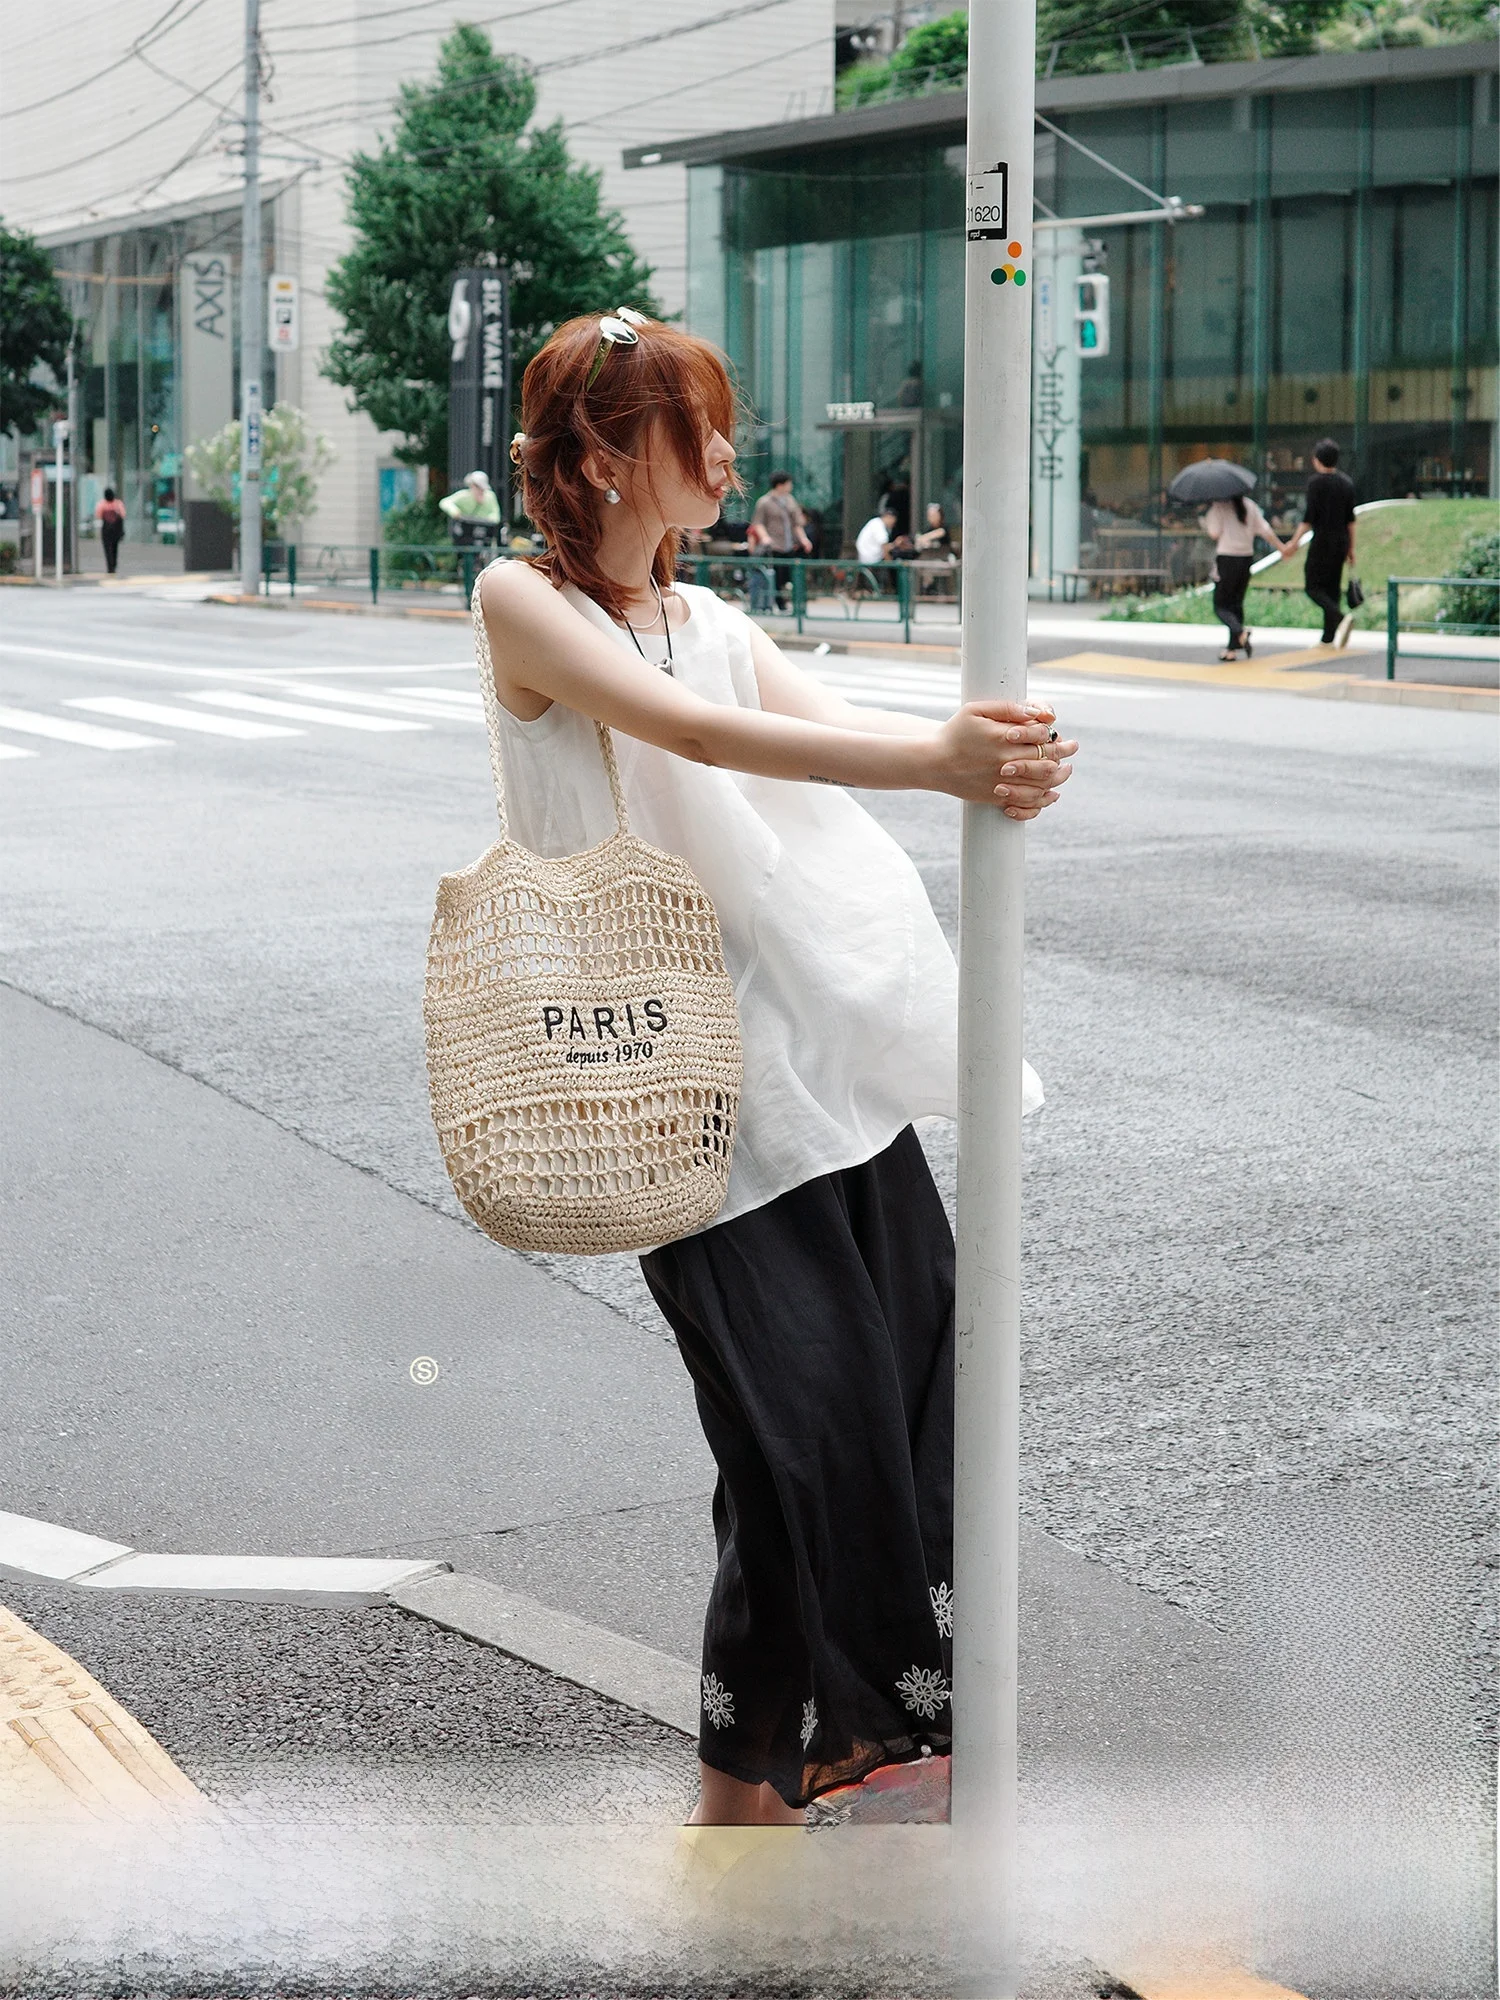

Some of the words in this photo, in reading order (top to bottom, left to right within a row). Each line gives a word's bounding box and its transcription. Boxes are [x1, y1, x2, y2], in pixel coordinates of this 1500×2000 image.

[194, 258, 225, 339] AXIS
[482, 278, 502, 317] SIX
[483, 321, 503, 389] WAKE
[1037, 345, 1074, 480] VERVE
[542, 998, 668, 1041] PARIS
[565, 1045, 609, 1070] depuis
[613, 1040, 653, 1064] 1970
